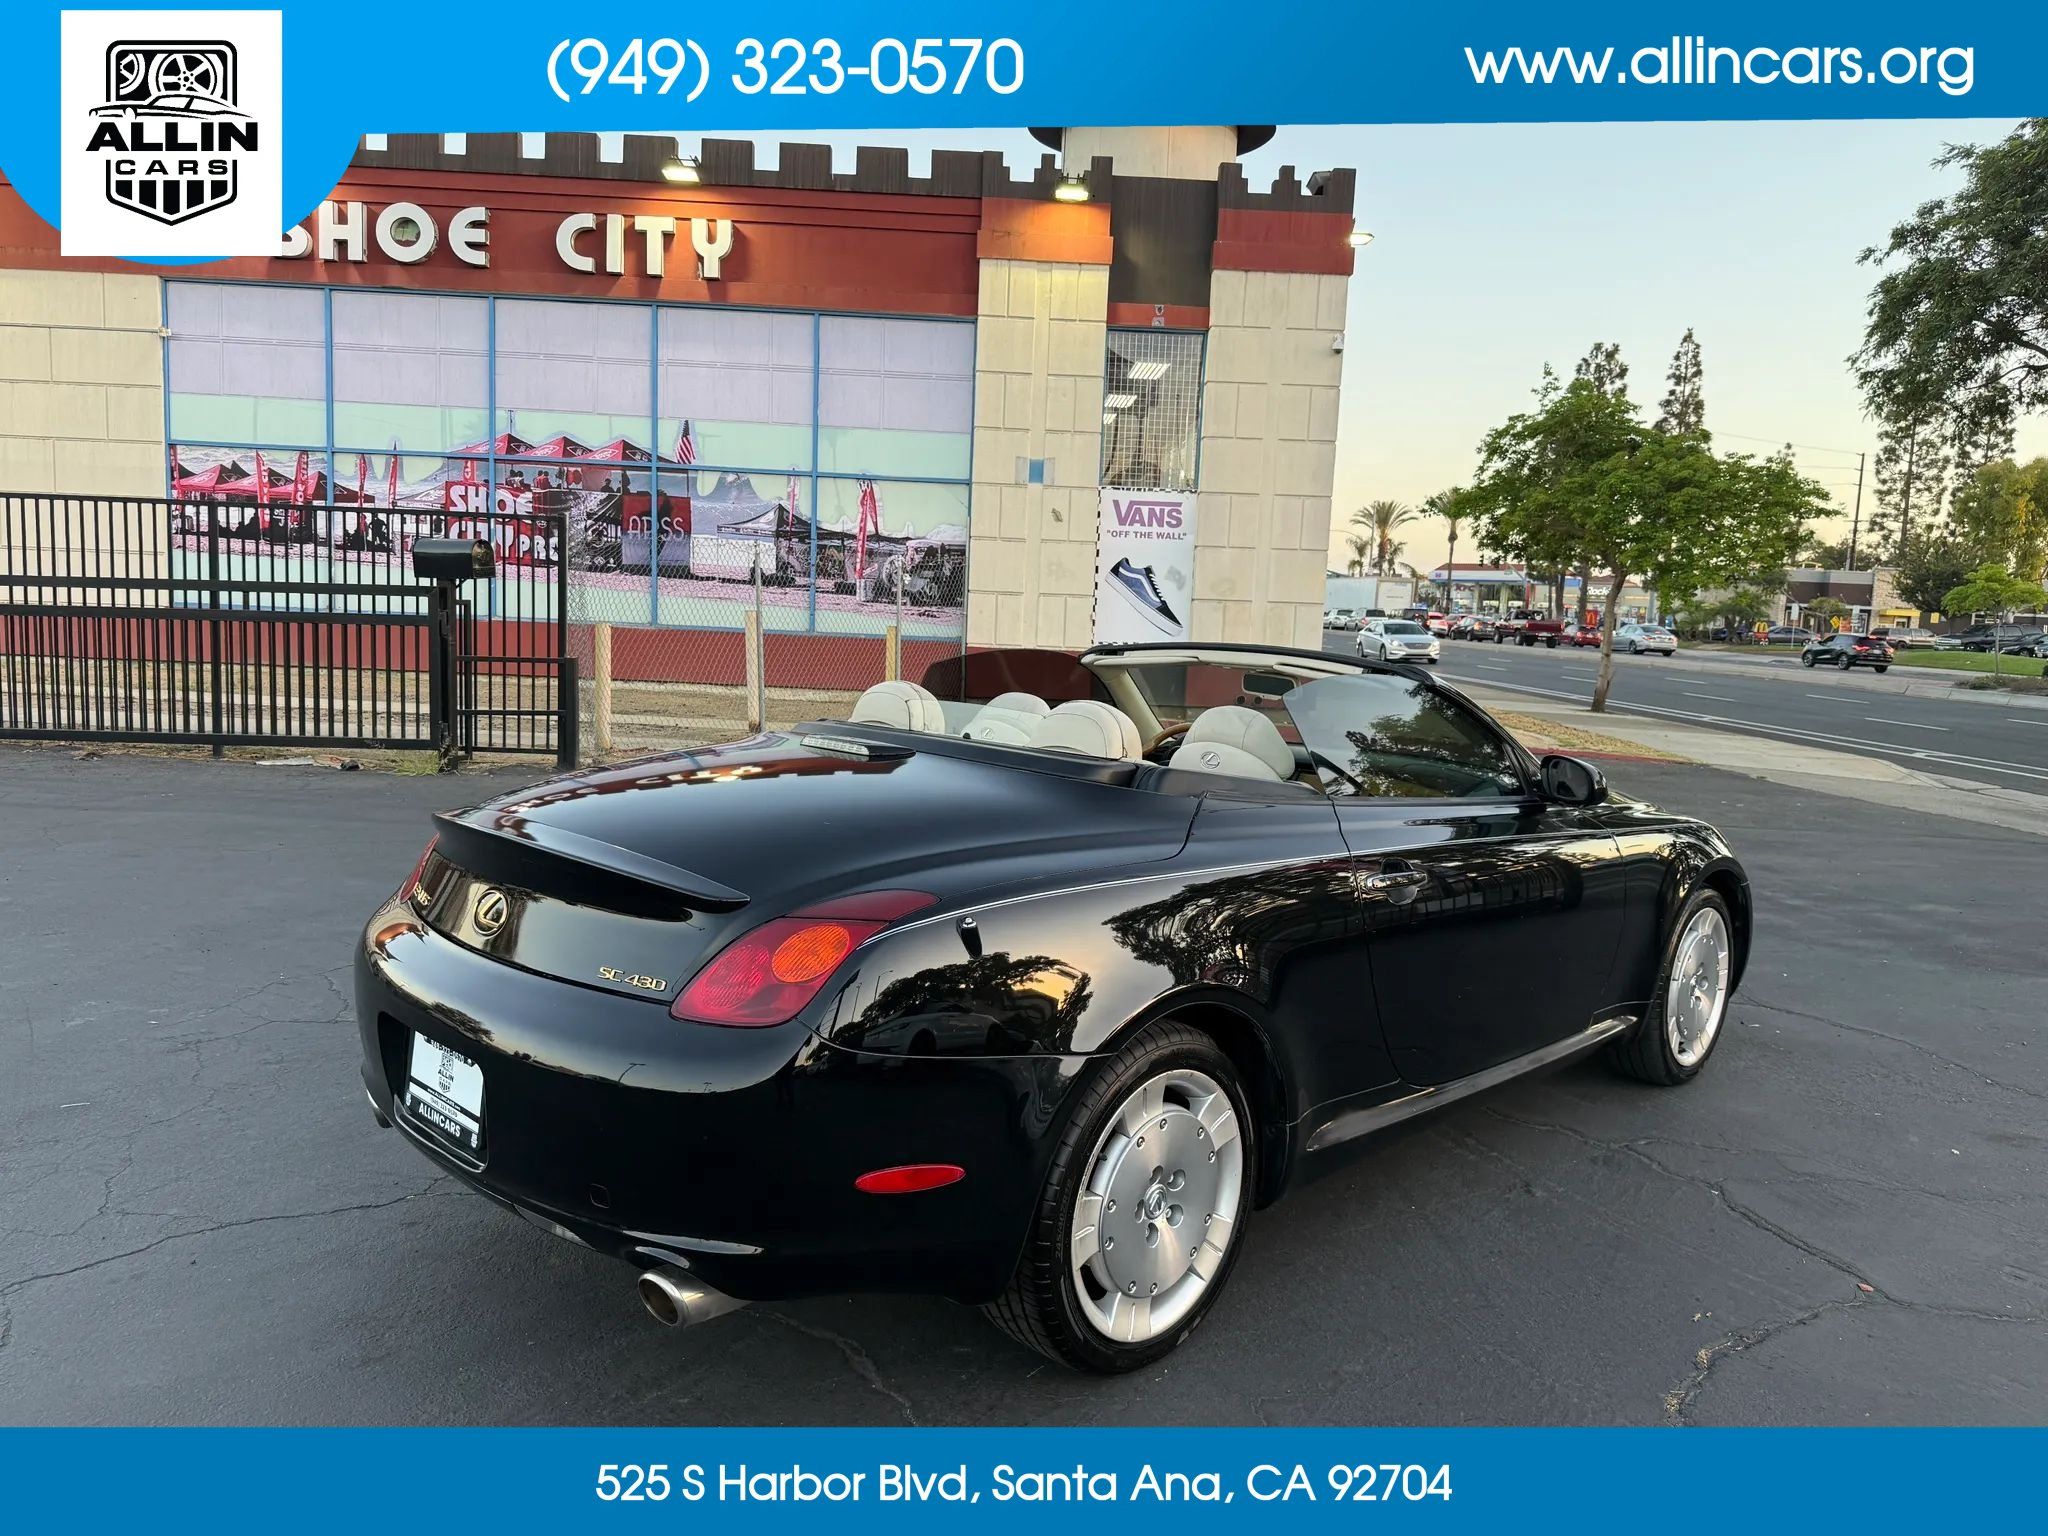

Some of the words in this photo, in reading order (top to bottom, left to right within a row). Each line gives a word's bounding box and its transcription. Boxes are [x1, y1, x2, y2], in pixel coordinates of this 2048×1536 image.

[555, 212, 734, 281] CITY
[449, 484, 532, 523] SHOE
[1112, 499, 1183, 529] VANS
[1133, 531, 1153, 539] THE
[597, 966, 625, 983] SC
[624, 974, 668, 992] 430
[418, 1102, 461, 1138] ALLINCARS
